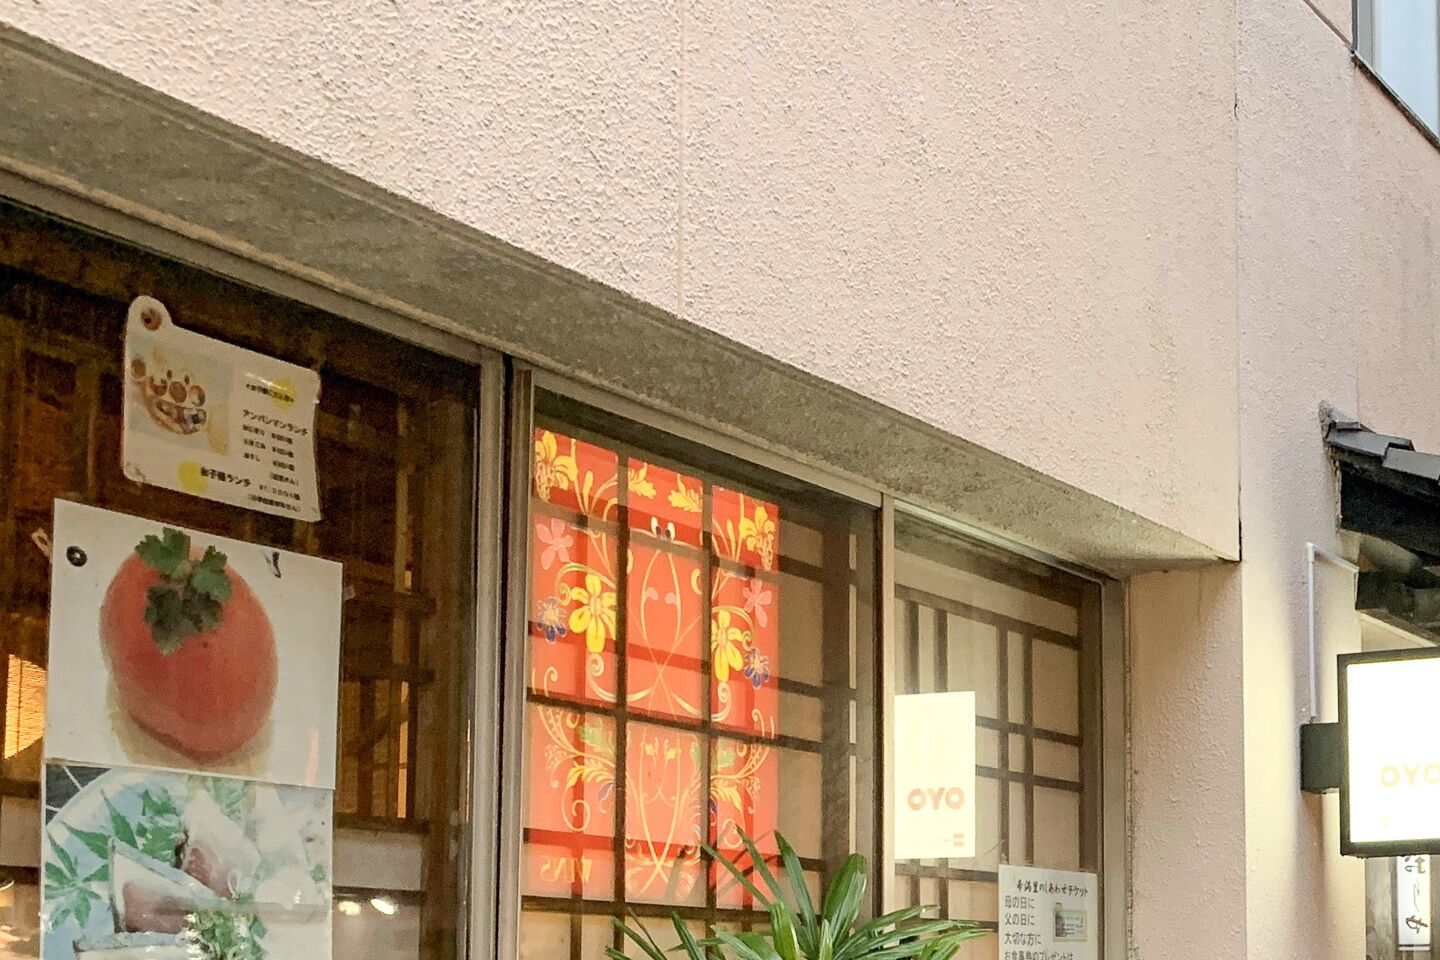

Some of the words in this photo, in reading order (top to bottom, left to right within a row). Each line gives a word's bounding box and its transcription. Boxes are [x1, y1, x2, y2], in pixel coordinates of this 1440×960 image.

[907, 786, 965, 811] OYO
[1004, 895, 1036, 909] 母の日に
[1004, 913, 1036, 926] 父の日に
[1004, 932, 1042, 946] 大切な方に
